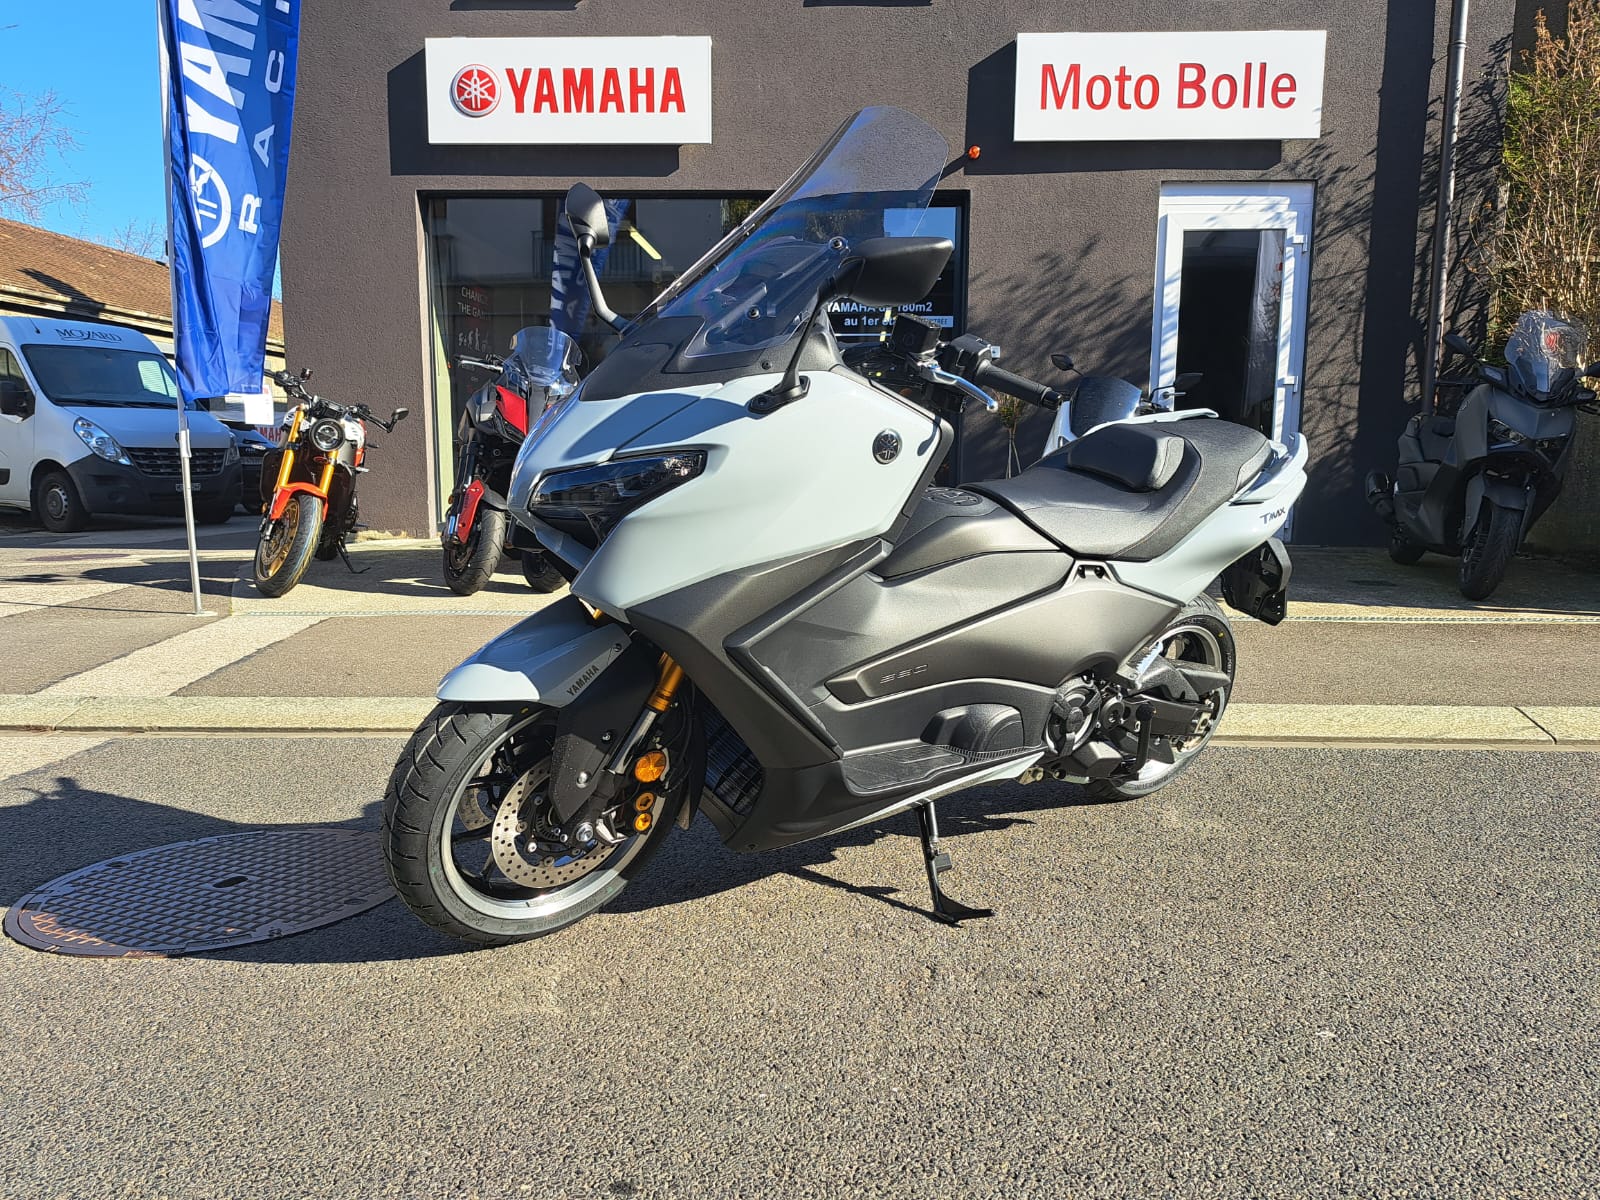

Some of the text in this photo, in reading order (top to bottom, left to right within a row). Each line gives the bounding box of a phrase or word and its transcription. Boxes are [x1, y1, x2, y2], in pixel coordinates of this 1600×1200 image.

[505, 67, 686, 113] YAMAHA
[1040, 62, 1297, 110] Moto Bolle
[458, 302, 472, 315] THE
[827, 302, 876, 312] YAMAHA
[844, 317, 858, 326] au
[862, 316, 879, 326] 1er
[566, 665, 600, 696] YAMAHA
